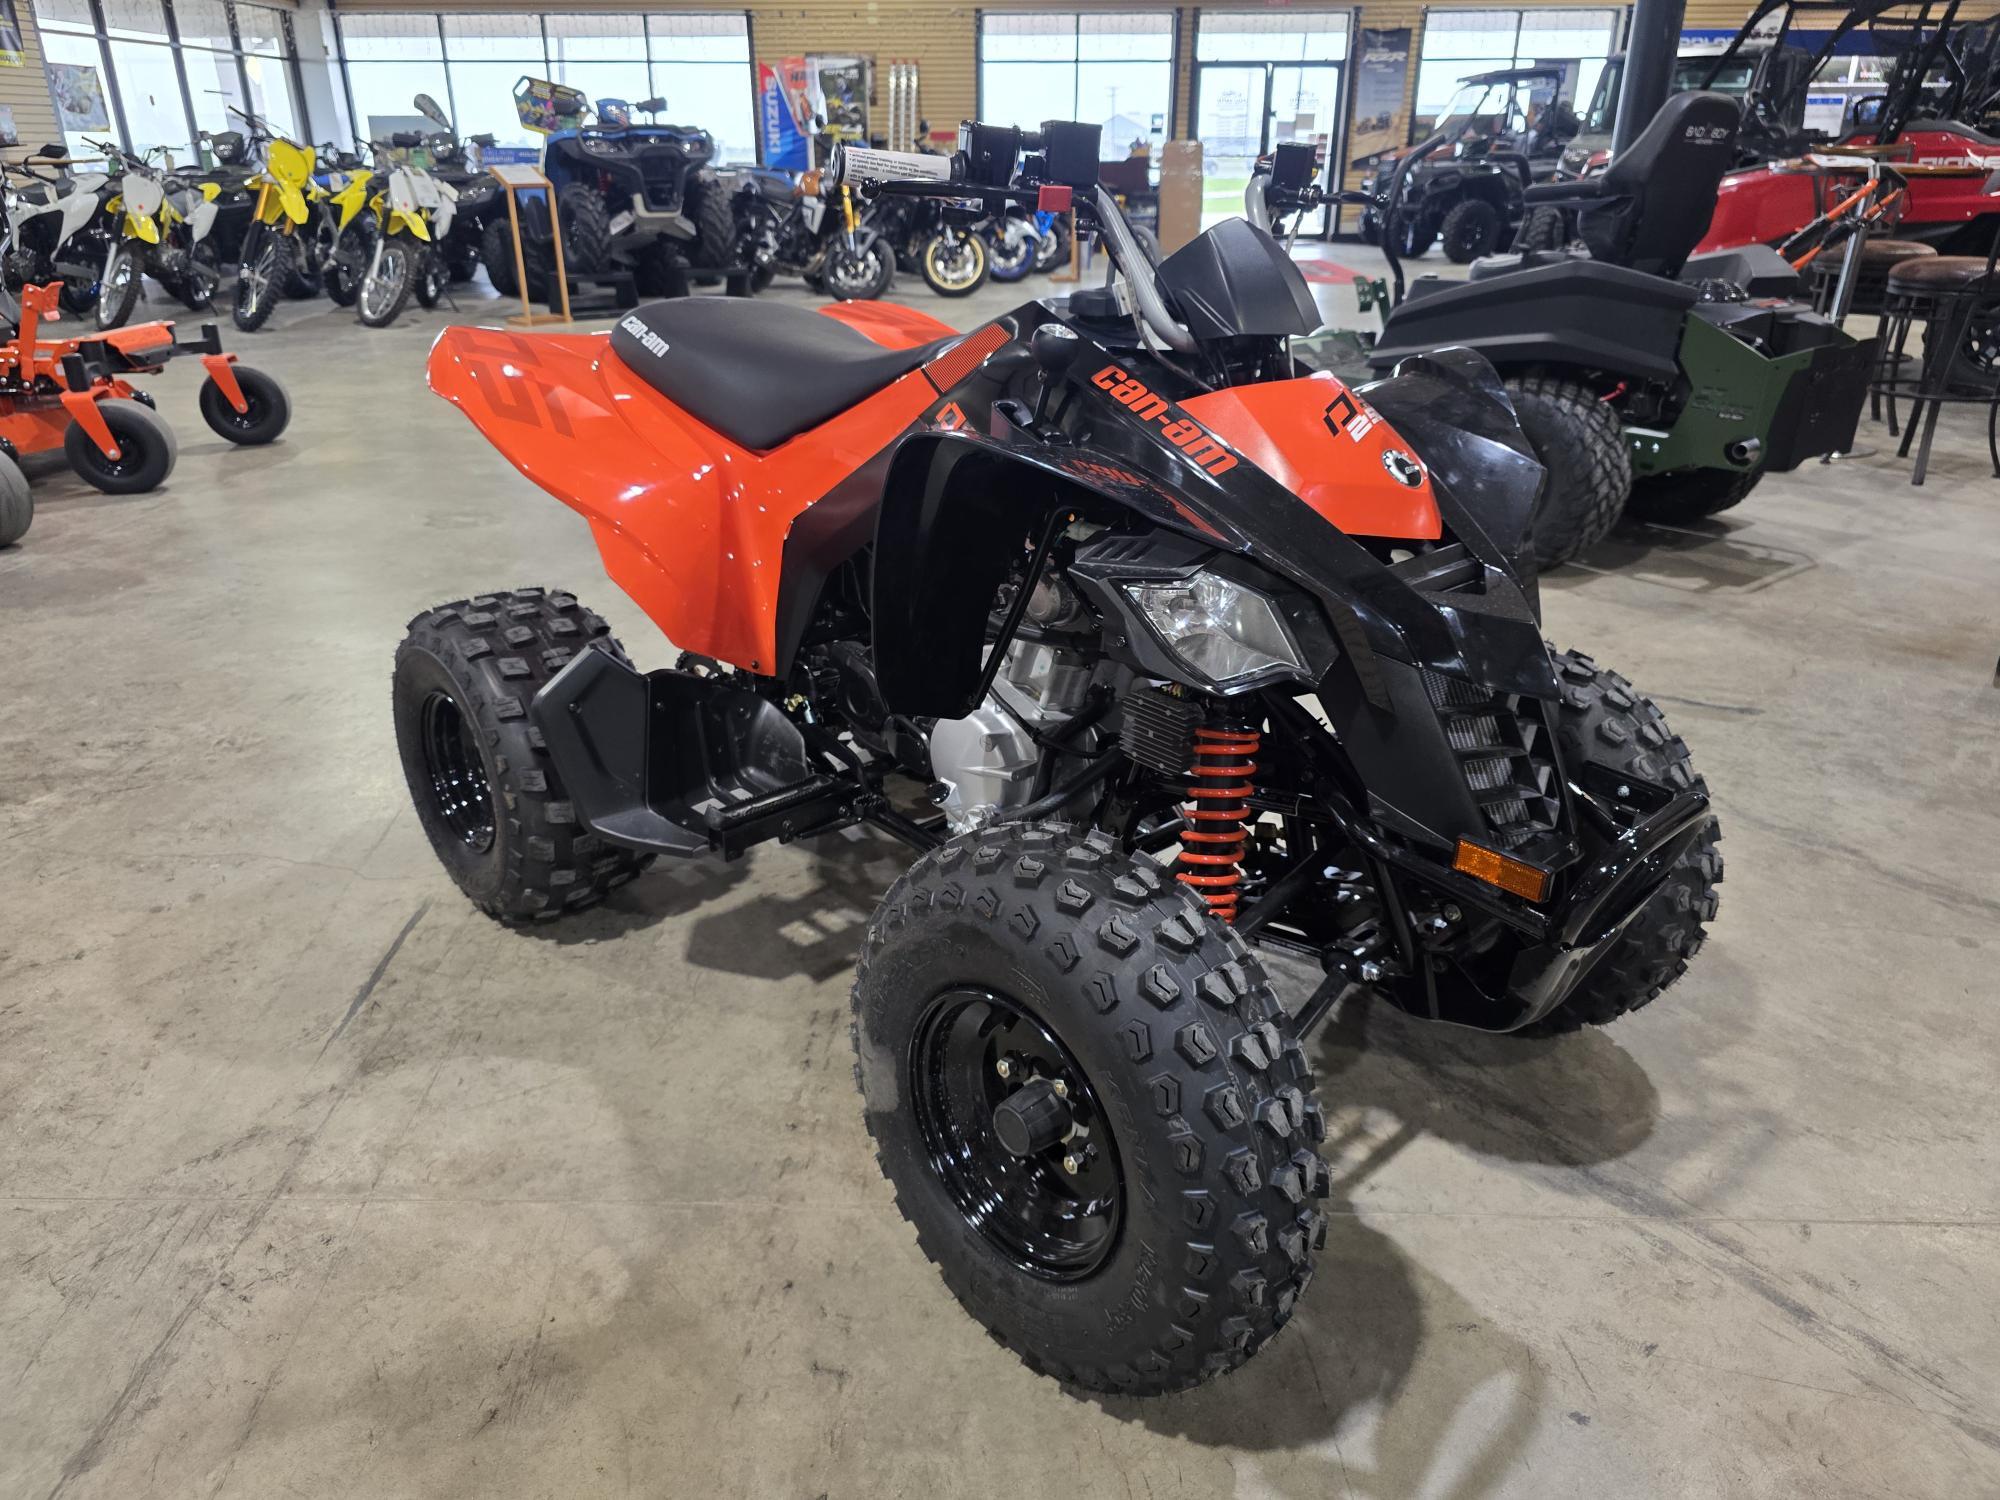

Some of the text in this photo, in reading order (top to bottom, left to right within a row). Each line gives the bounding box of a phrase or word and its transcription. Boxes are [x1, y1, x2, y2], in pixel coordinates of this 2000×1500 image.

[765, 77, 780, 154] SUZUKI
[621, 315, 670, 358] can-am
[1091, 365, 1239, 476] can-am
